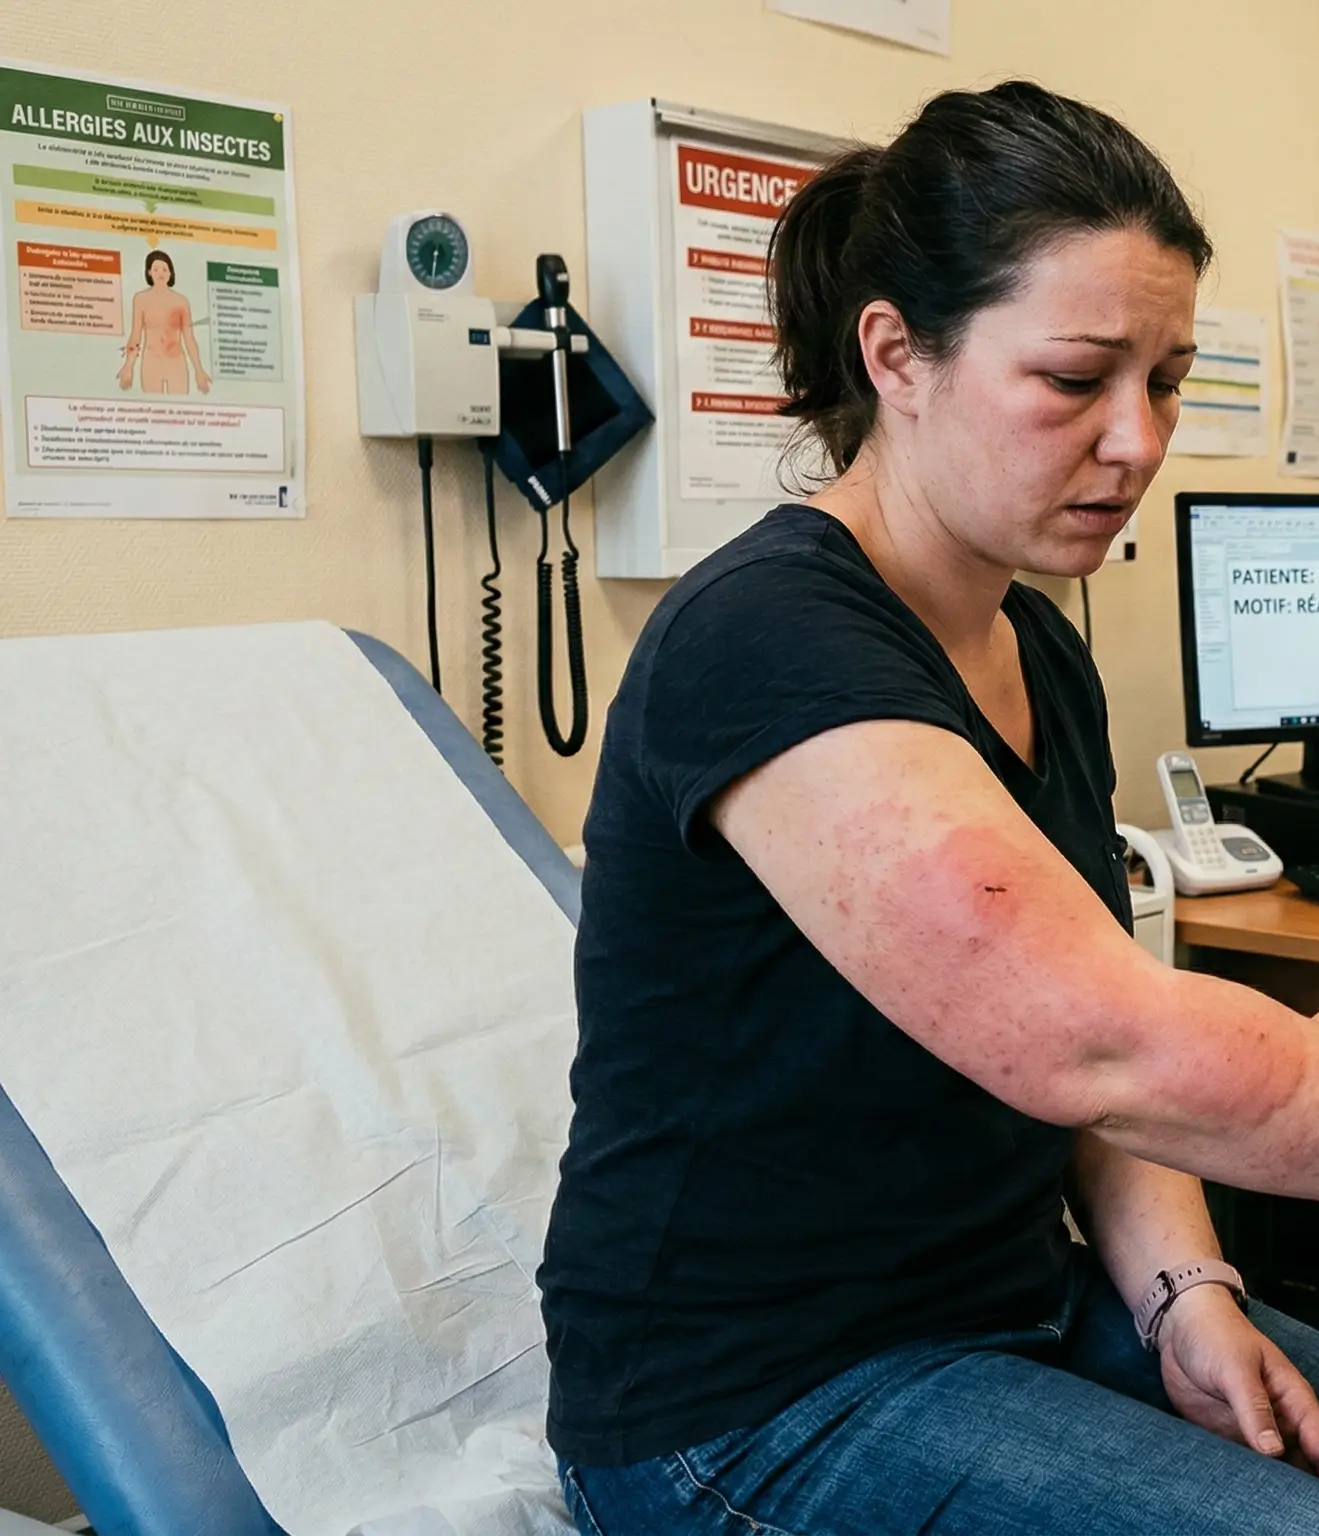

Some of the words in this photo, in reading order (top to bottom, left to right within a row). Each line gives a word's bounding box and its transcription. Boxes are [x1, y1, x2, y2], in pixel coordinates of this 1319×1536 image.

[12, 103, 127, 140] ALLERGIES
[132, 122, 174, 148] AUX
[180, 130, 271, 162] INSECTES
[1232, 568, 1315, 585] PATIENTE:
[1233, 598, 1292, 615] MOTIF:
